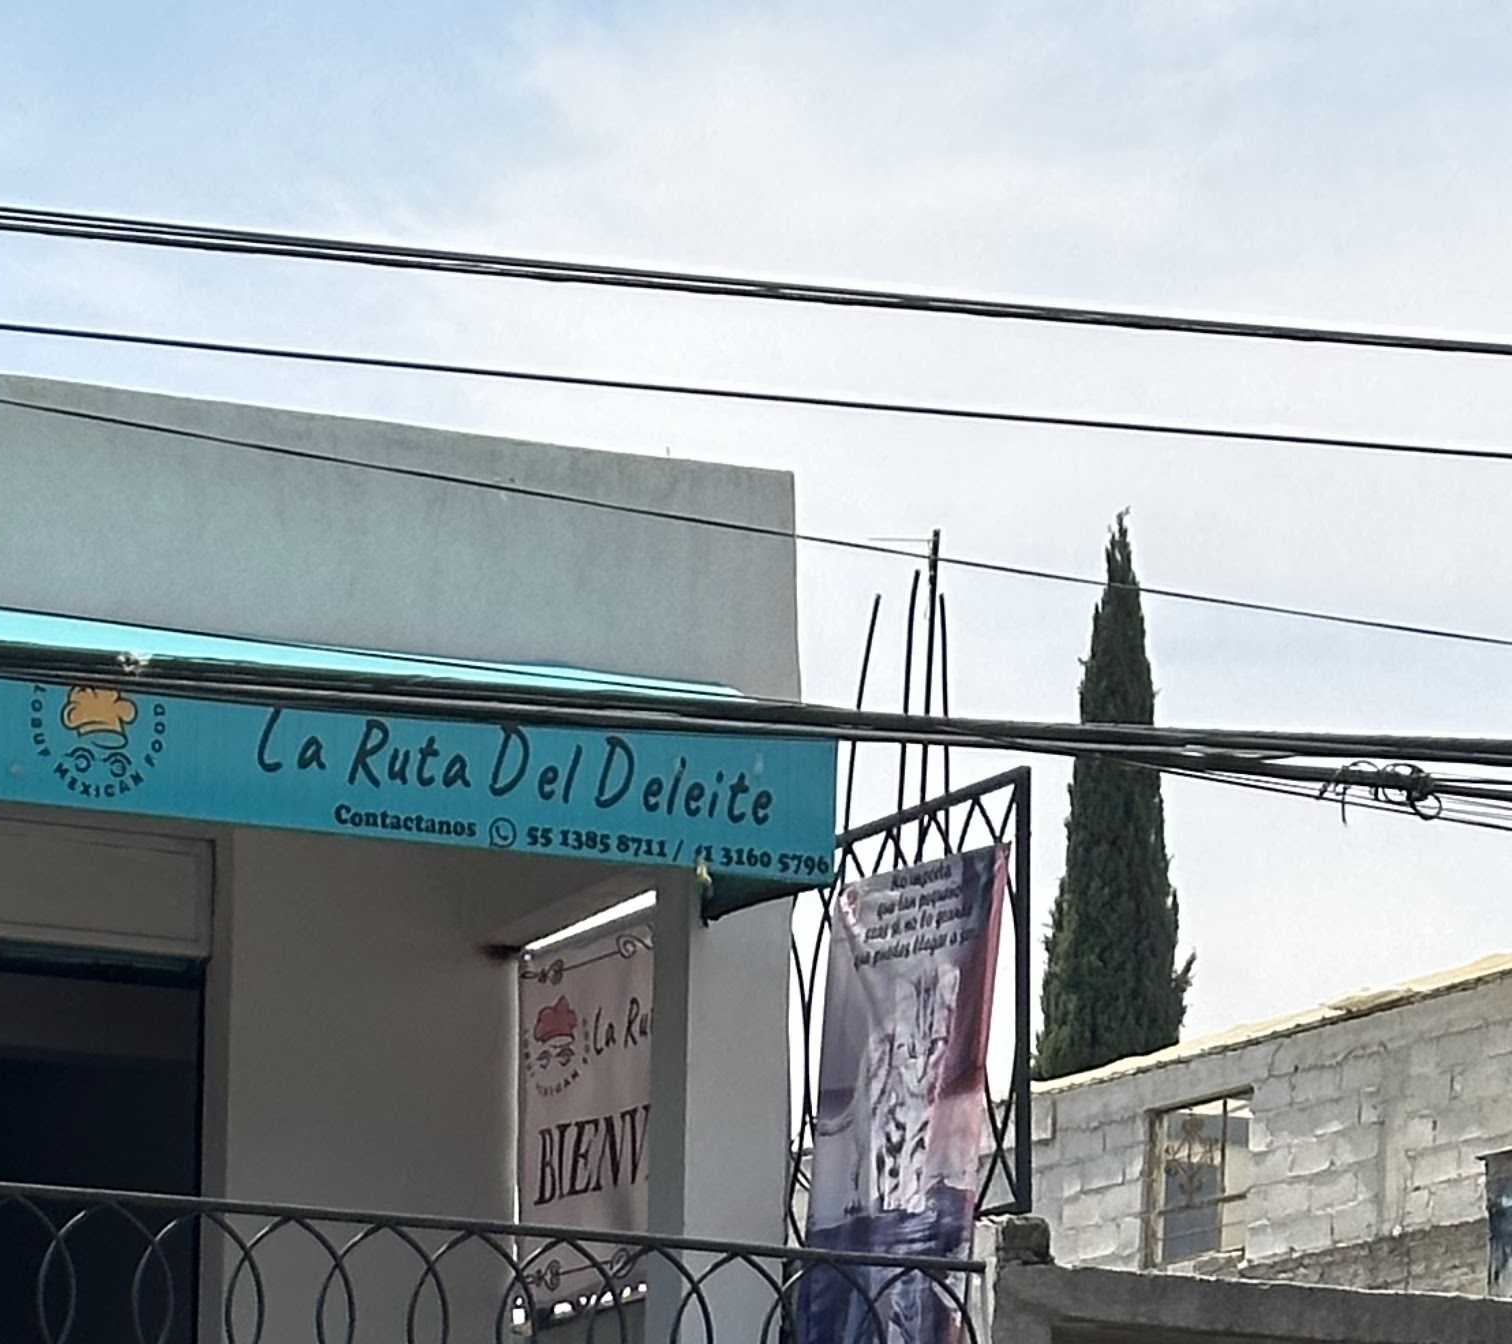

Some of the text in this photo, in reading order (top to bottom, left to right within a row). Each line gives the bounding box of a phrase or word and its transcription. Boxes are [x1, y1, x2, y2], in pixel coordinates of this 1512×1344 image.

[53, 762, 144, 798] MEXICAN
[144, 703, 166, 767] FOOD
[258, 707, 773, 825] La Ruta Del Deleite
[334, 803, 477, 837] Contactanos
[527, 826, 553, 847] 55
[560, 830, 610, 852] 1385
[616, 834, 667, 857] 8711
[672, 839, 684, 862] /
[721, 846, 771, 867] 3160
[778, 853, 829, 876] 5796
[594, 997, 653, 1055] La Ru
[534, 1103, 652, 1206] BIENV
